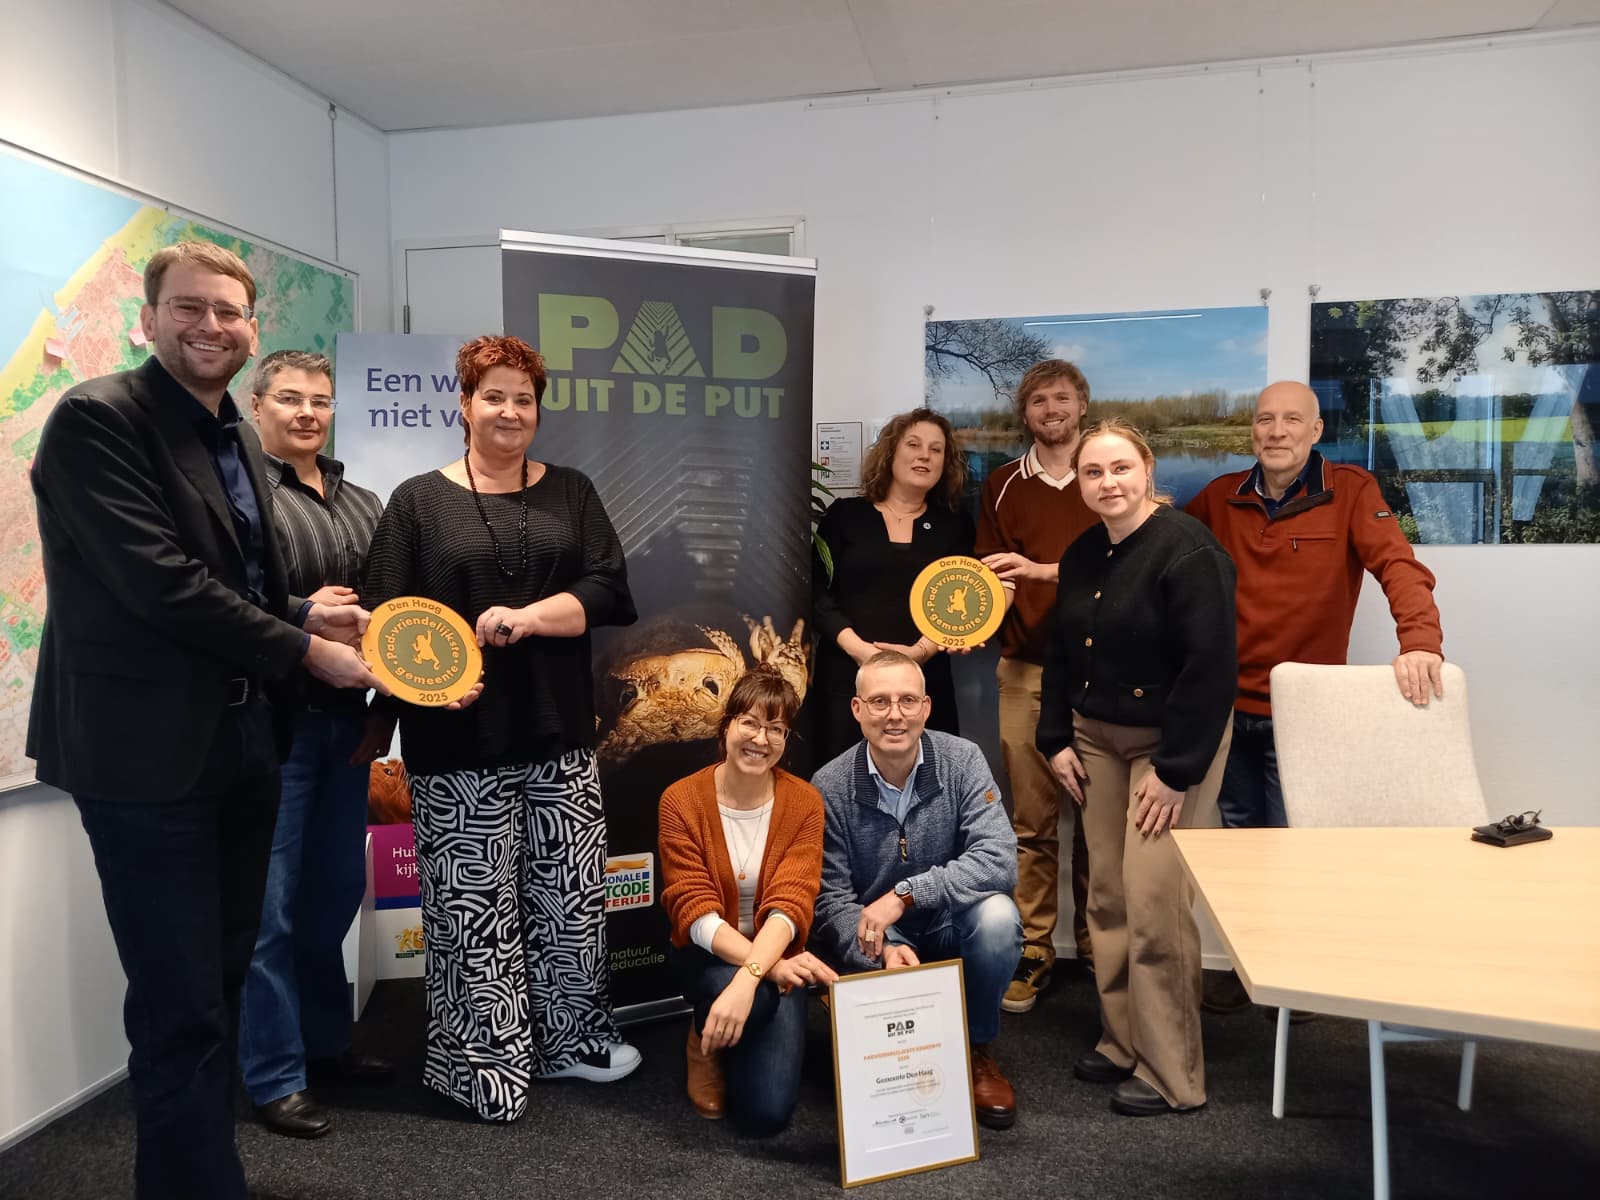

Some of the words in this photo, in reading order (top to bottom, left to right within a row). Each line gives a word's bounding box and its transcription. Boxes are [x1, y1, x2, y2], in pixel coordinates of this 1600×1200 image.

[537, 293, 788, 380] PAD
[366, 367, 422, 392] Een
[430, 374, 460, 392] w
[541, 377, 615, 412] UIT
[632, 381, 687, 415] DE
[704, 385, 785, 418] PUT
[368, 401, 432, 428] niet
[940, 559, 957, 568] Den
[960, 558, 984, 573] Haag
[387, 601, 409, 612] Den
[412, 599, 442, 615] Haag
[930, 613, 981, 632] gemeente
[942, 636, 966, 647] 2025
[395, 667, 458, 685] gemeente
[419, 692, 448, 702] 2025
[605, 872, 641, 885] IONALE
[606, 881, 649, 899] TCODE
[605, 895, 641, 908] TERIJ
[610, 953, 665, 970] educatie
[887, 1019, 915, 1033] PAD
